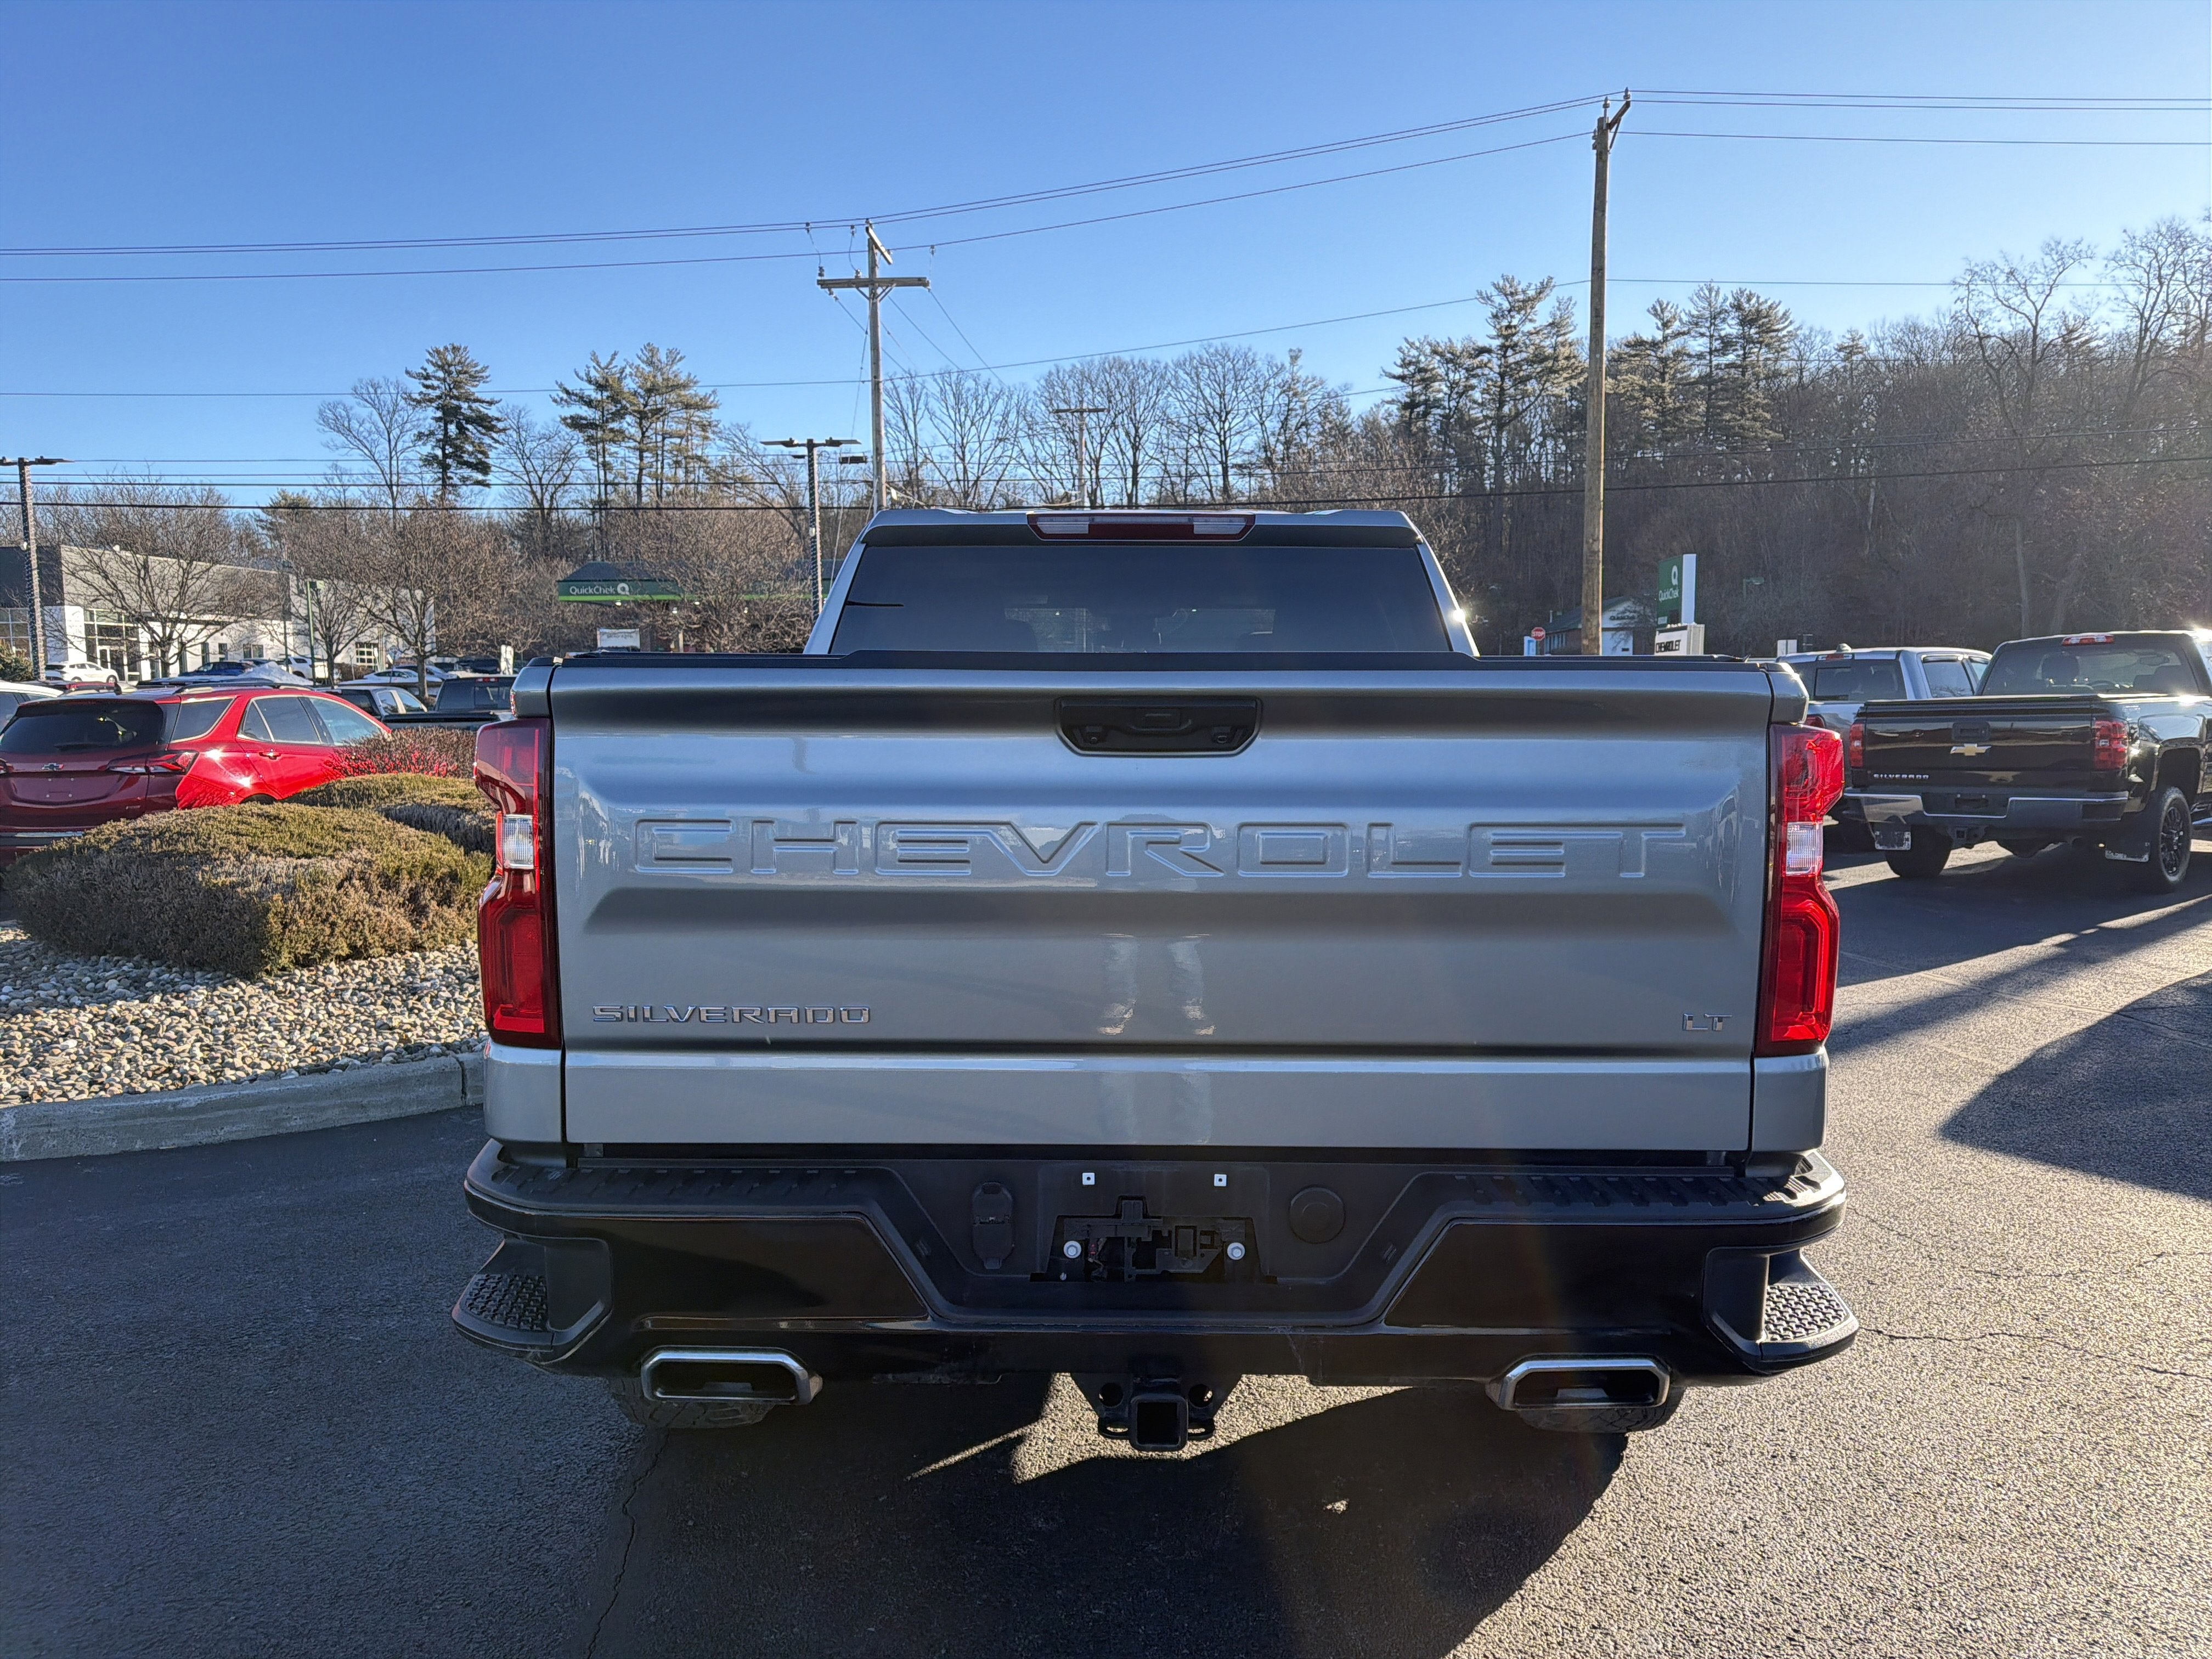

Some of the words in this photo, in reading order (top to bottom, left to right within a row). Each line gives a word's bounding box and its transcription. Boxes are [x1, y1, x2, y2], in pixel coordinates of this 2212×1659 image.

[569, 585, 615, 595] QuickChek
[1658, 588, 1679, 602] QuickChek
[1655, 639, 1681, 653] CHEVROLET
[635, 819, 1685, 877] CHEVROLET
[592, 1005, 871, 1024] SILVERADO
[1682, 1013, 1733, 1031] LT
